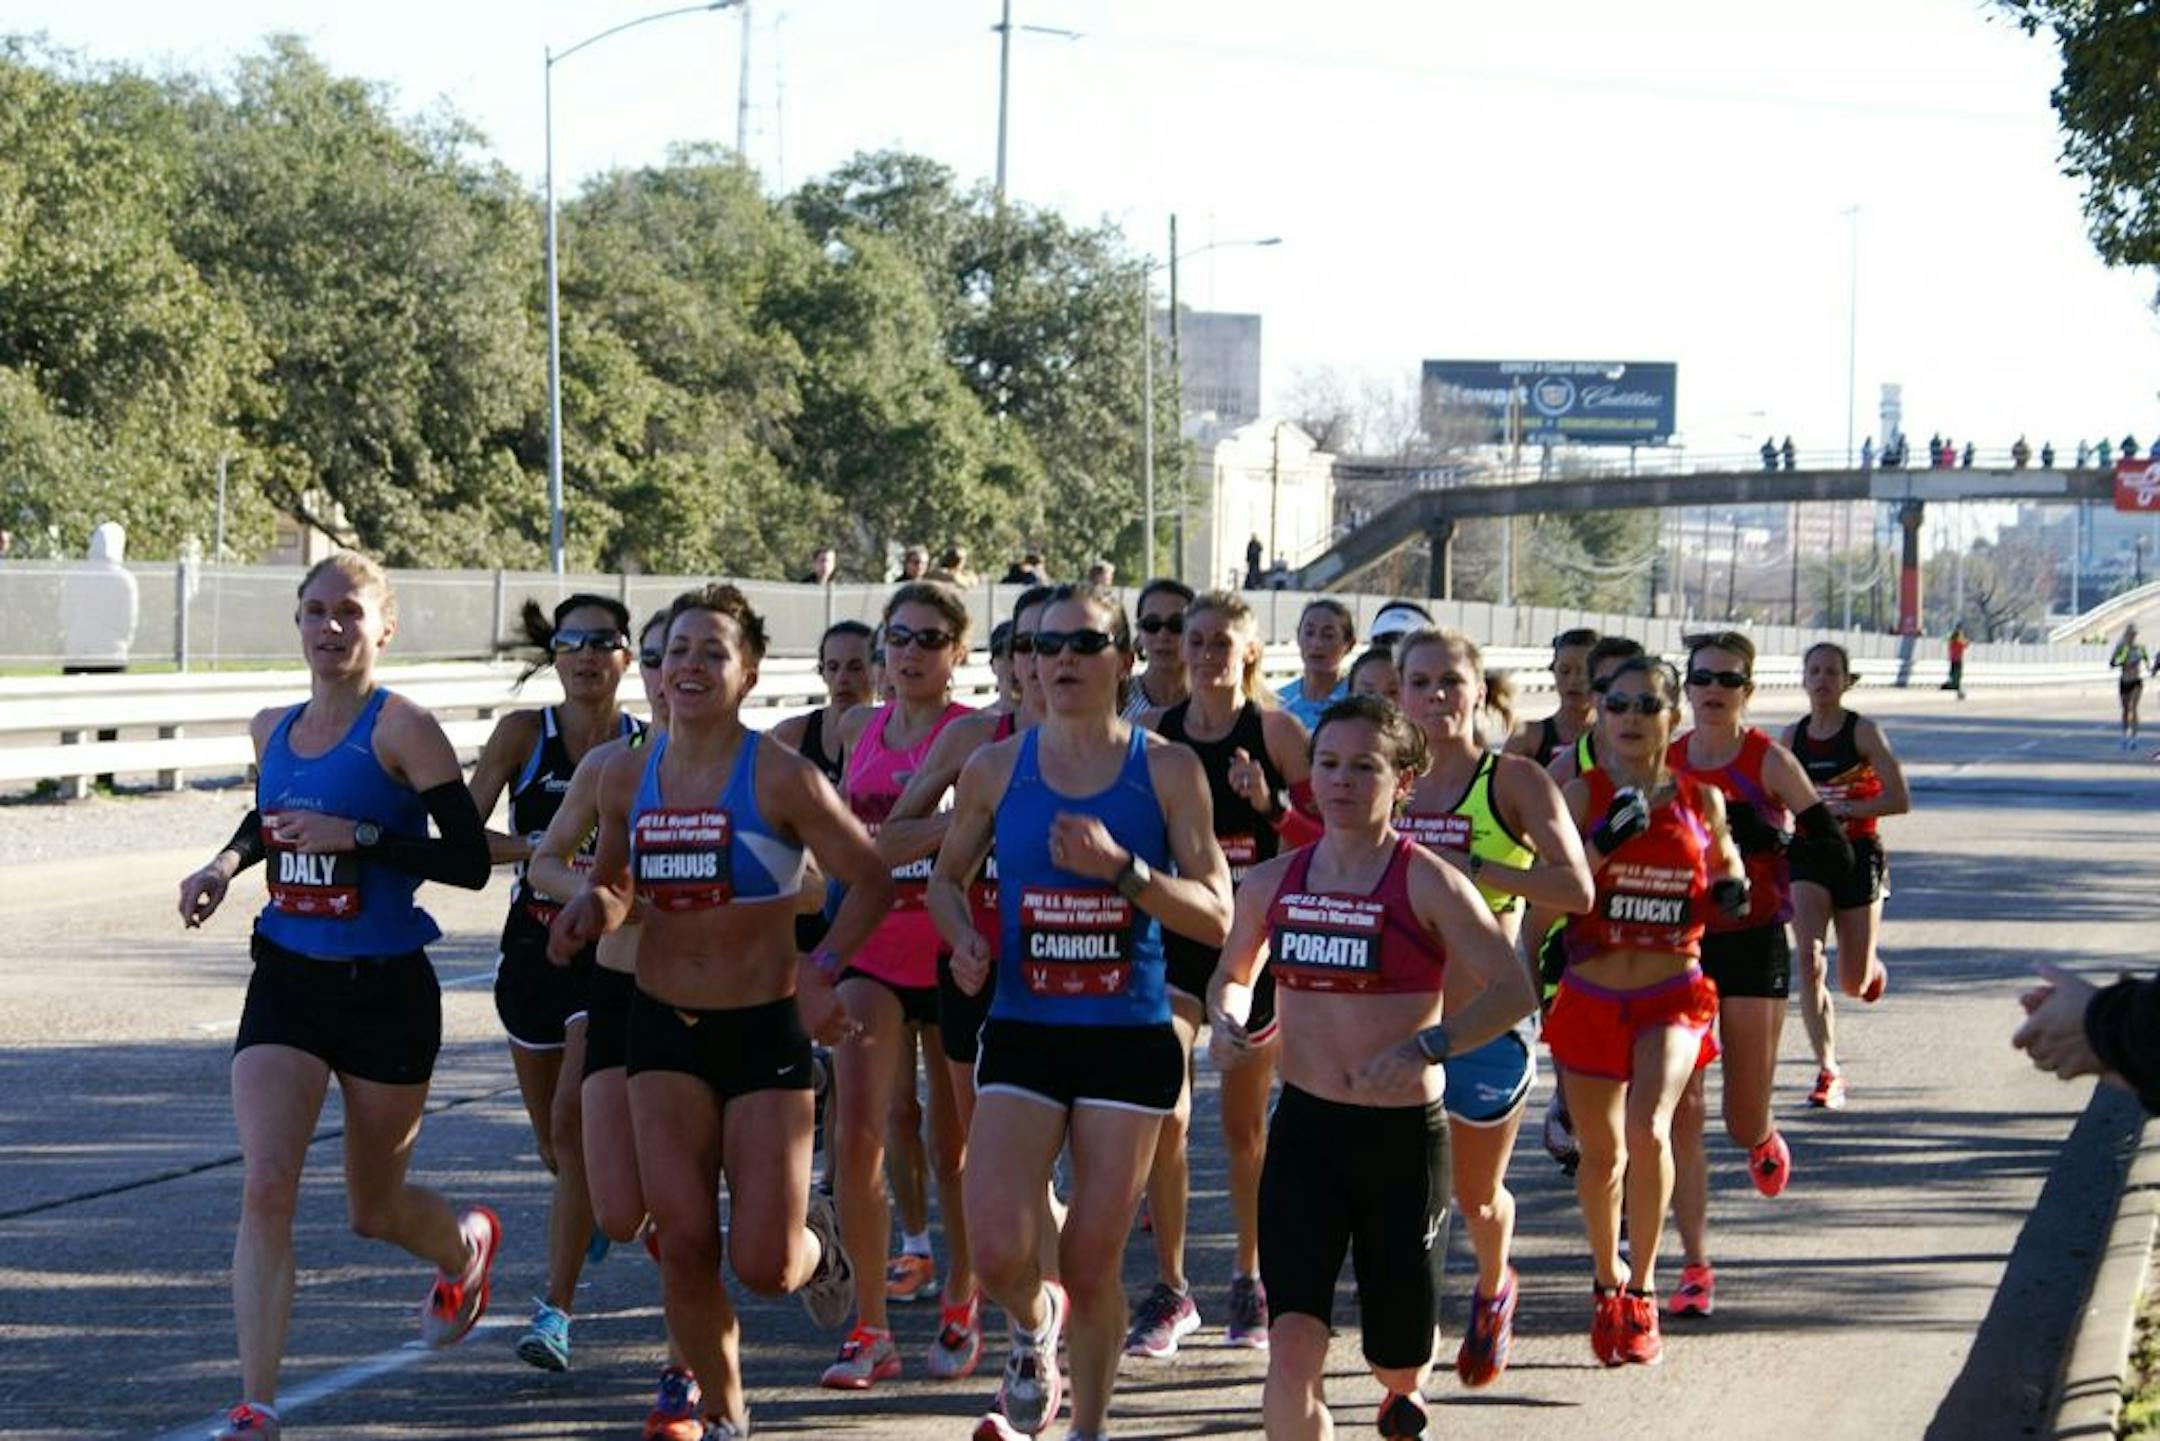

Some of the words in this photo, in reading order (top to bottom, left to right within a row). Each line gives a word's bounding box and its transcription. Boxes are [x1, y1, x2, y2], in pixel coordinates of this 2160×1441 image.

[279, 852, 337, 886] DALY
[640, 852, 718, 880] NIEHUUS
[1076, 910, 1123, 924] Marathon
[1609, 894, 1684, 924] STUCKY
[1029, 932, 1121, 960] CARROLL
[1280, 931, 1369, 968] PORATH
